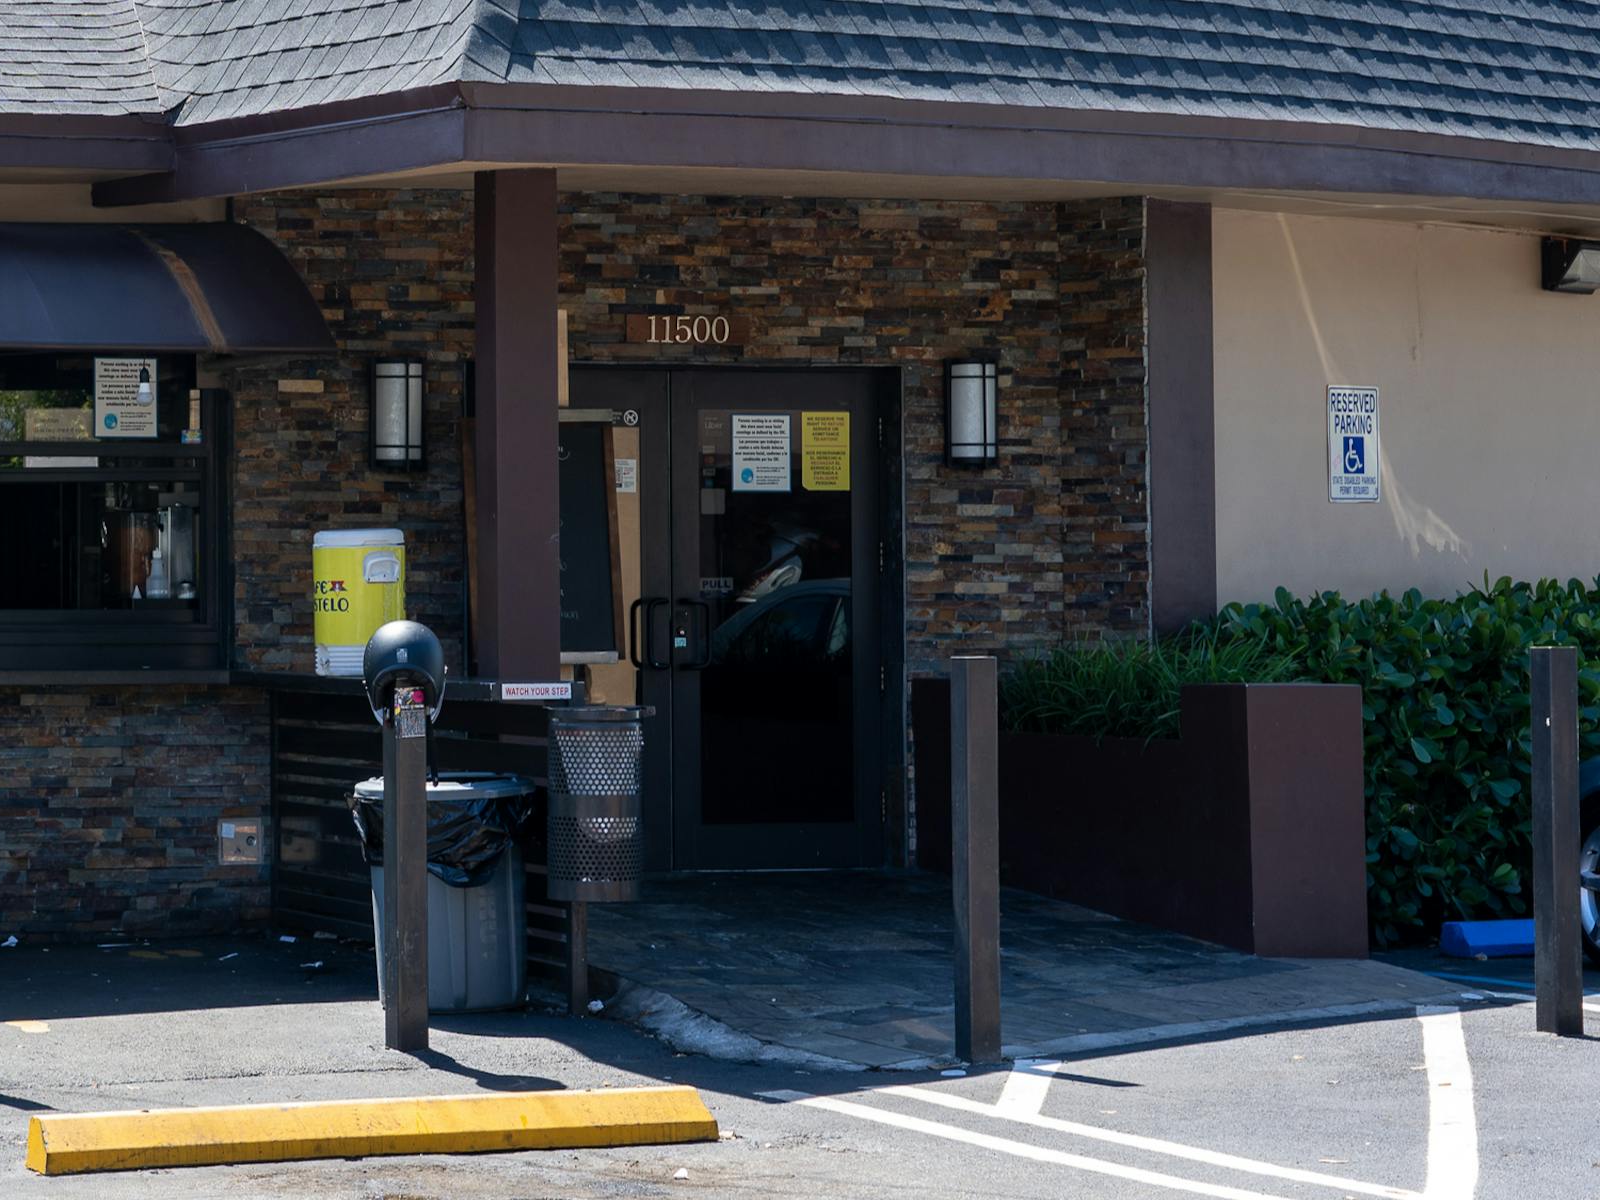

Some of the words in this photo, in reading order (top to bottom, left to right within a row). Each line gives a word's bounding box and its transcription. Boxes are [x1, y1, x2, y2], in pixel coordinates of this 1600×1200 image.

[646, 315, 730, 344] 11500
[1330, 392, 1376, 414] RESERVED
[1334, 414, 1373, 434] PARKING
[702, 580, 731, 589] PULL
[505, 687, 529, 696] WATCH
[530, 687, 550, 696] YOUR
[551, 687, 569, 696] STEP
